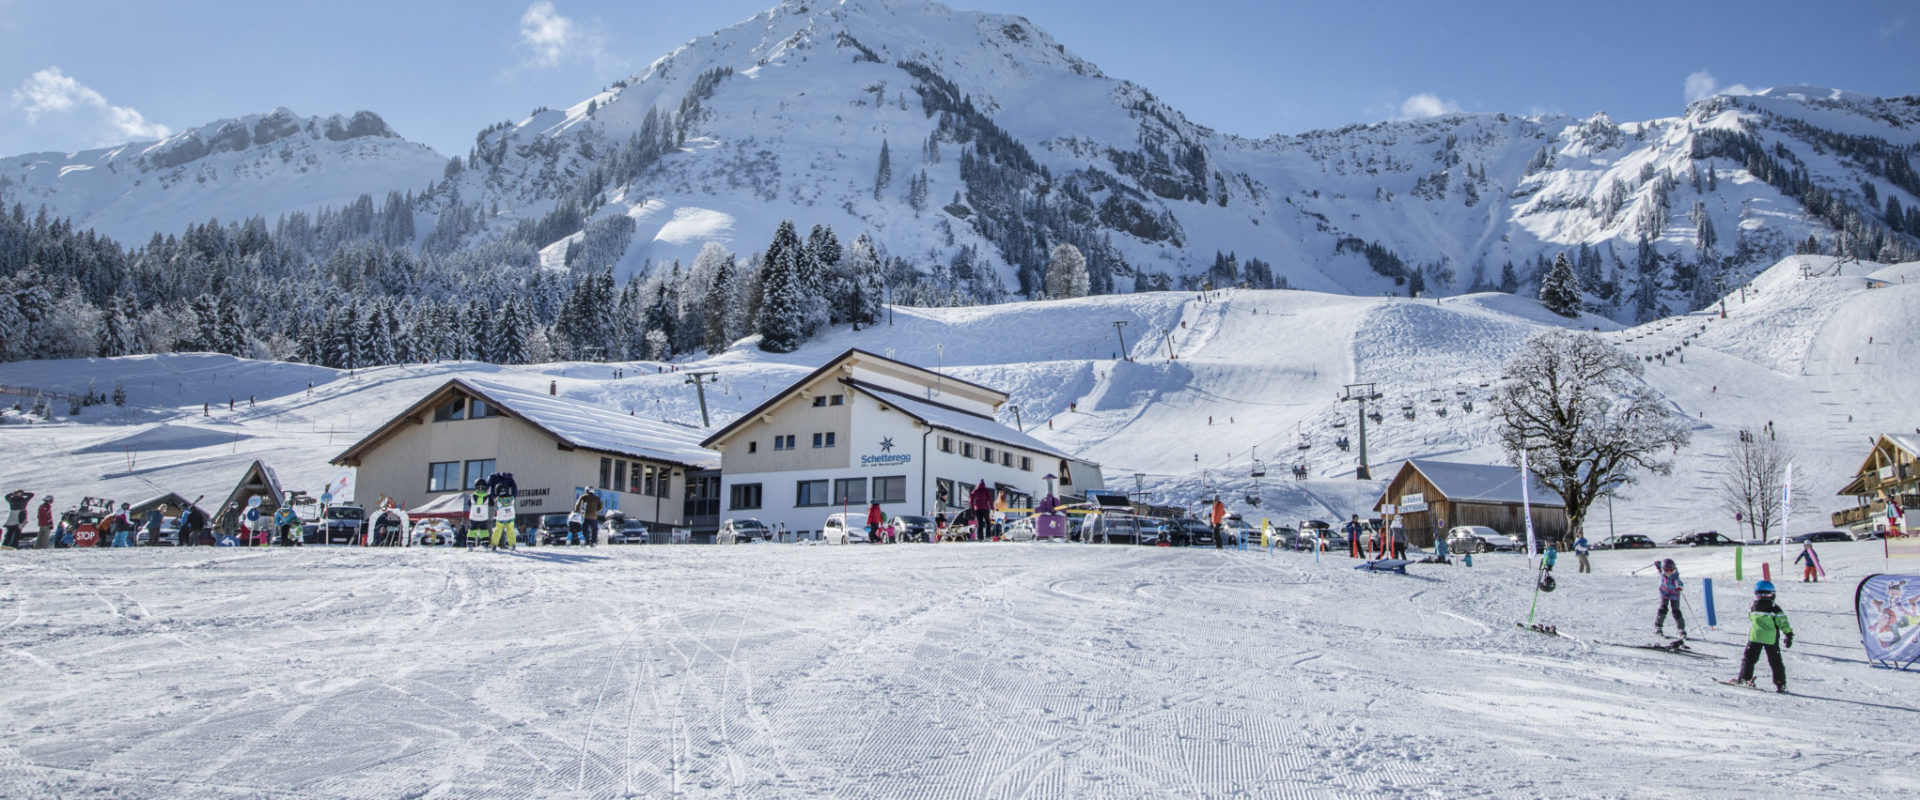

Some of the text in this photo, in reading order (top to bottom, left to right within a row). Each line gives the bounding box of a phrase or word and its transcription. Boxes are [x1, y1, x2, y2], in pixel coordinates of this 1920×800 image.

[861, 453, 911, 464] Schetteregg
[517, 488, 550, 497] ESTAURANT
[76, 531, 95, 541] STOP
